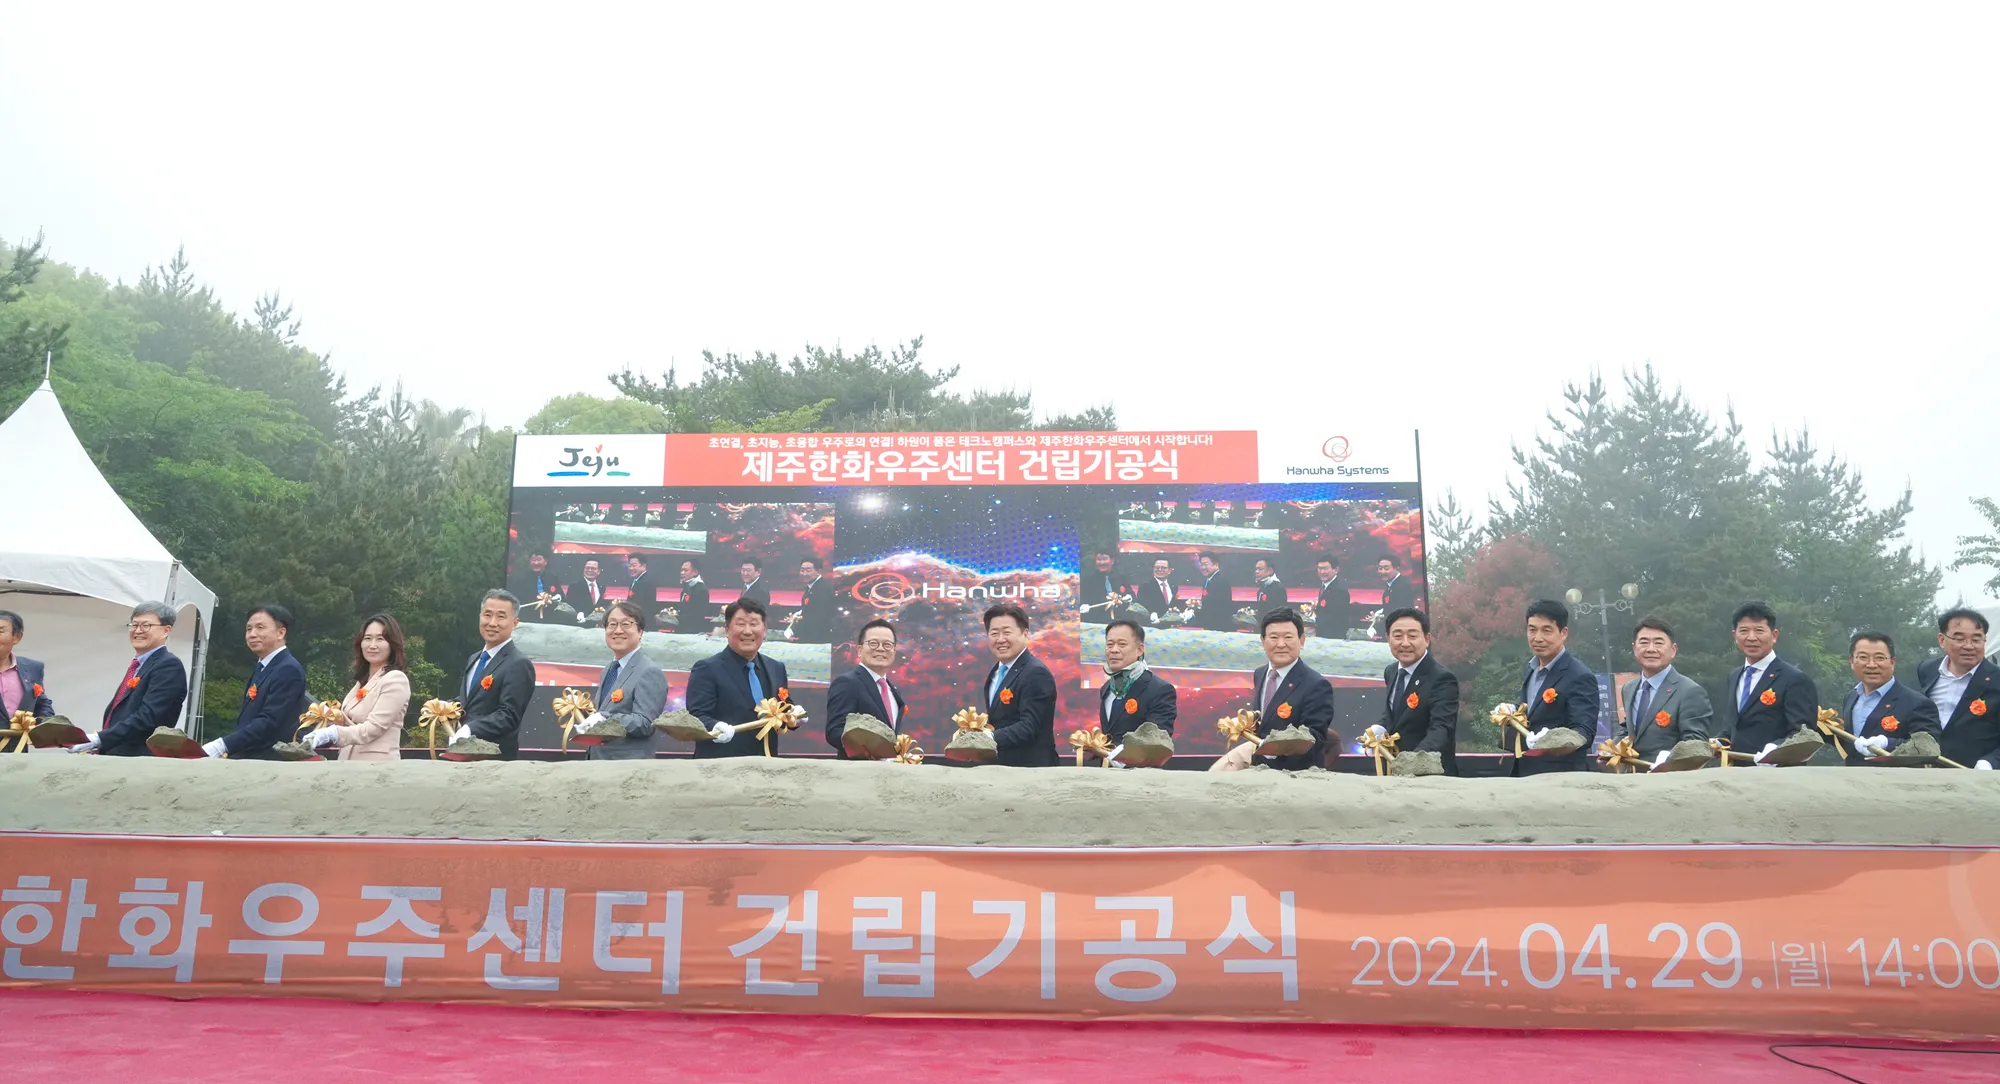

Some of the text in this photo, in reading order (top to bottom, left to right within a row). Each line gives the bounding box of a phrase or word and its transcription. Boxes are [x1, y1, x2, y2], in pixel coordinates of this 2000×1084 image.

[709, 437, 744, 449] 초연결,
[747, 437, 782, 449] 초지능,
[822, 436, 866, 448] 우주로의
[869, 436, 894, 448] 연결!
[897, 436, 930, 447] 하원이
[933, 436, 955, 447] 품은
[958, 435, 1036, 447] 테크노캠퍼스와
[1039, 435, 1151, 446] 제주한화우주센터에서
[1154, 434, 1213, 446] 시작합니다!
[558, 444, 620, 477] Jeju
[741, 449, 1179, 482] 제주한화우주센터 건립기공식
[1286, 466, 1390, 477] Hanwha Systems
[922, 582, 1061, 598] Hanwha
[0, 875, 1300, 1001] 한화우주센터 건립기공식
[1846, 937, 2000, 989] 14:00
